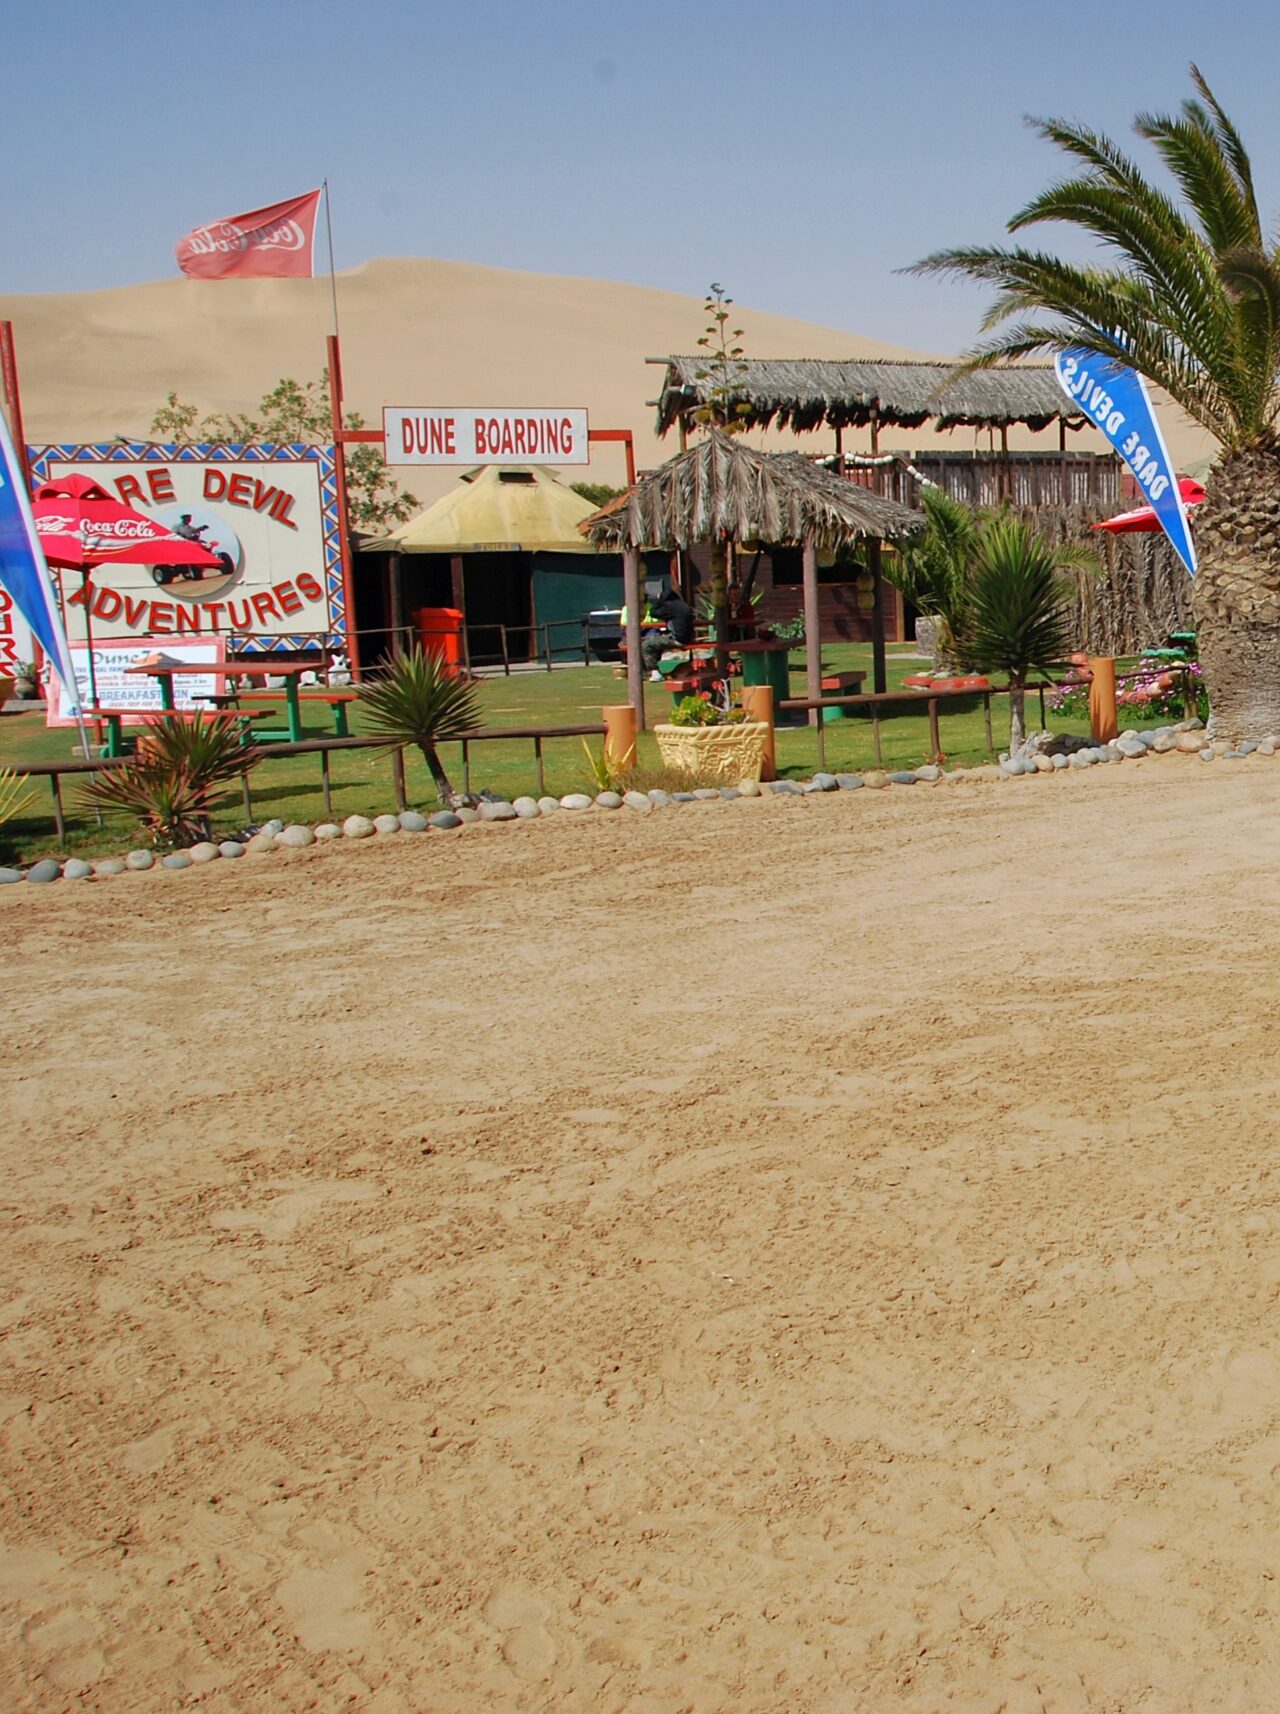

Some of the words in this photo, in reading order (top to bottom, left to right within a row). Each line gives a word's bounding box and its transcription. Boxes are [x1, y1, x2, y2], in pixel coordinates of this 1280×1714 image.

[401, 417, 456, 455] DUNE
[474, 417, 573, 455] BOARDING
[113, 468, 176, 508] RE
[203, 468, 297, 529] DEVIL
[79, 518, 156, 537] Coca-Cola
[67, 572, 323, 633] ADVENTURES
[99, 689, 162, 701] BREAKFAST
